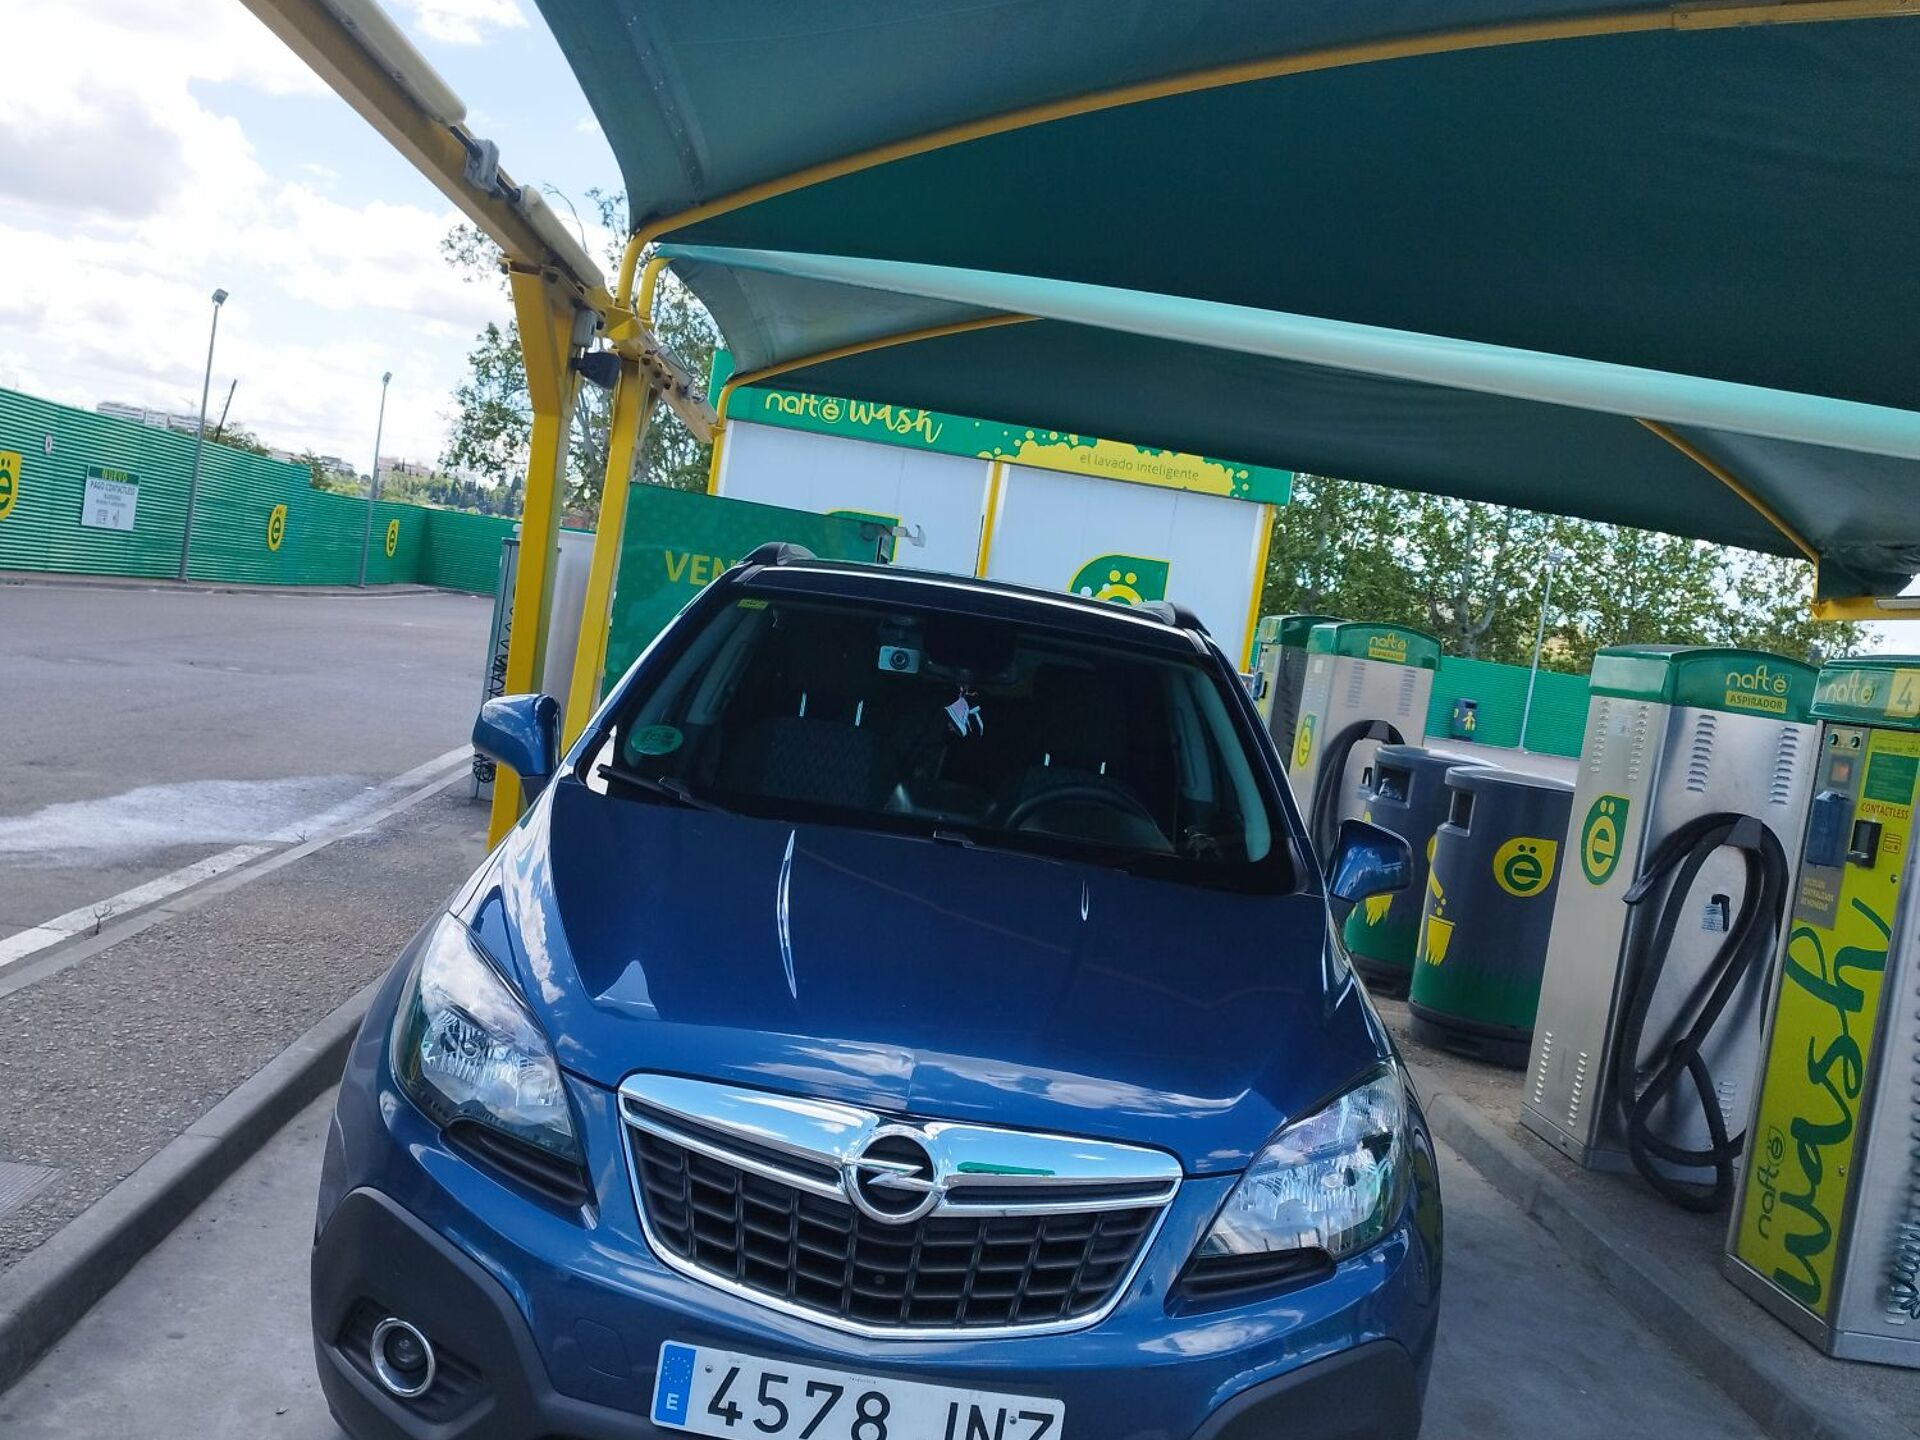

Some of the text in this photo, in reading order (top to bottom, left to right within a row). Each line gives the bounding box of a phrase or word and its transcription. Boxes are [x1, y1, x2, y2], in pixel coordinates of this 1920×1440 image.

[850, 399, 942, 443] wash
[1079, 453, 1199, 481] el lavado inteligente
[1730, 694, 1783, 710] ASPIRADOR
[1896, 677, 1912, 712] 4
[1861, 801, 1909, 820] CONTACTLESS
[1773, 897, 1892, 1305] wash
[666, 1393, 679, 1411] E
[707, 1366, 891, 1440] 4578
